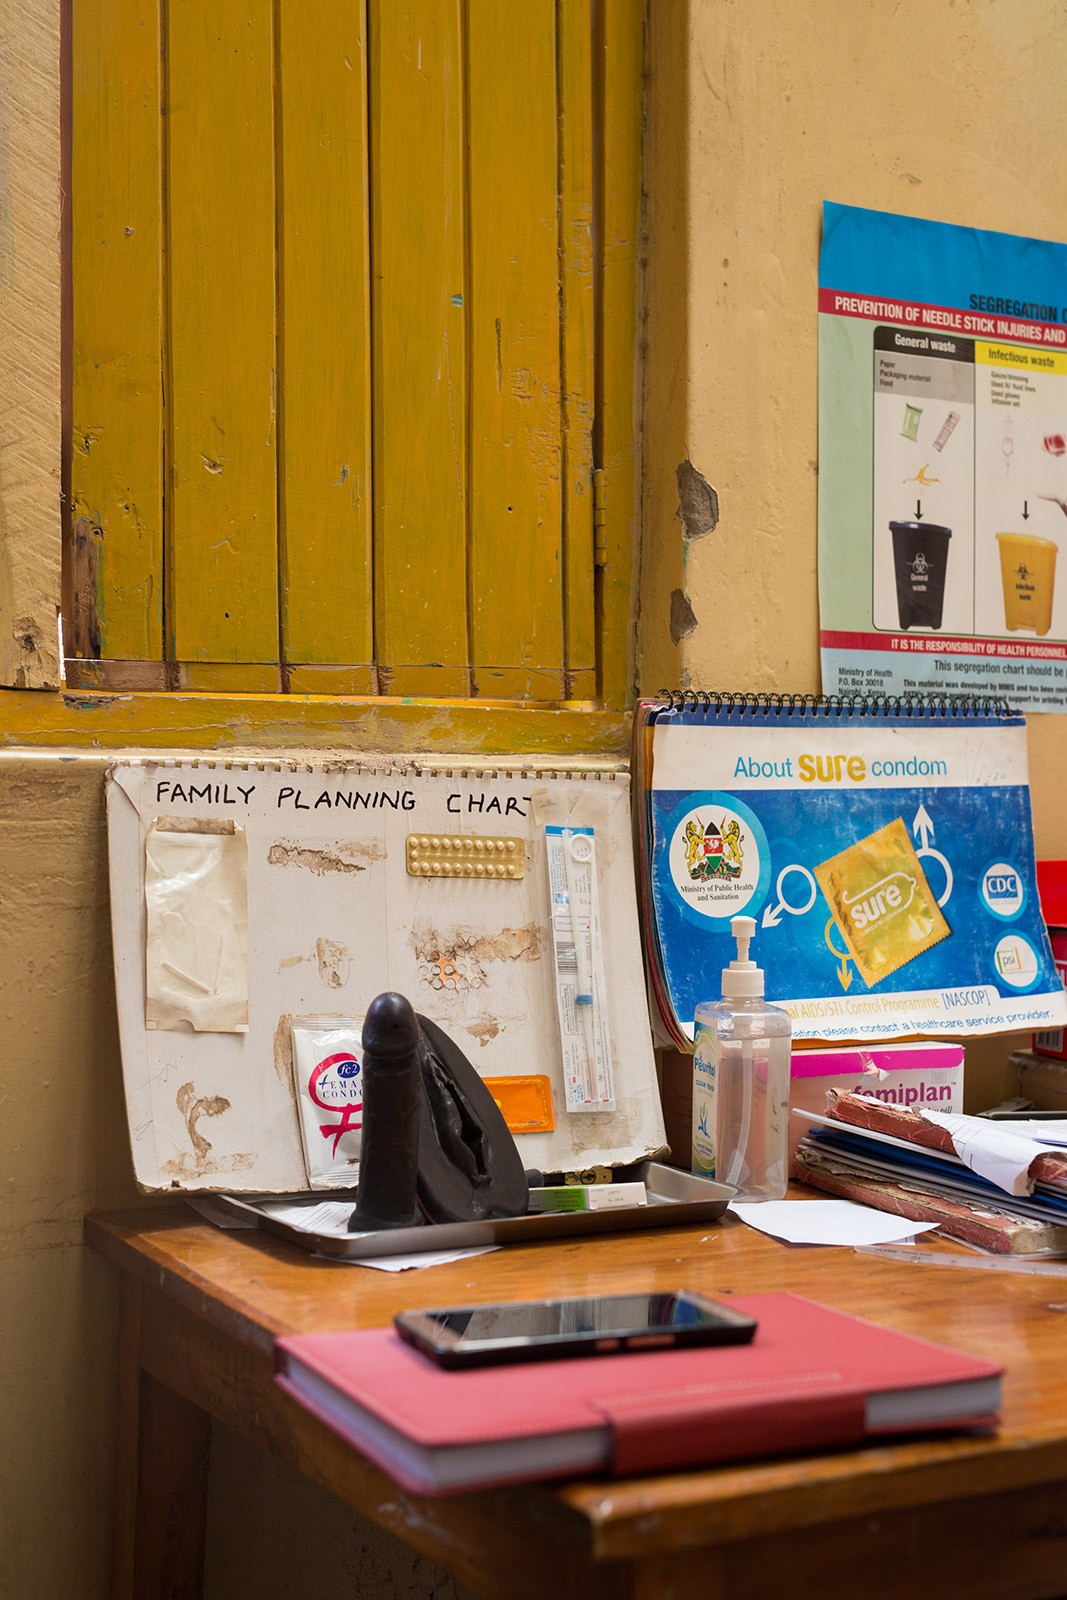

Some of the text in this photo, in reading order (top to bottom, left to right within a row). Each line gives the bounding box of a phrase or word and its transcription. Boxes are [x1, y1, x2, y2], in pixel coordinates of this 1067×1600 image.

[970, 293, 1058, 322] SEGREGATION
[835, 296, 1066, 343] PREVENTION OF NEEDLE STICK INJURIES AND
[895, 333, 957, 354] General waste
[880, 359, 896, 369] Paper
[988, 348, 1055, 368] Infectious waste
[880, 369, 931, 382] Packaging material
[880, 379, 893, 387] Food
[891, 639, 899, 650] IT
[900, 639, 908, 650] IS
[909, 640, 924, 651] THE
[925, 641, 986, 653] RESPONSIBILITY
[986, 643, 997, 654] OF
[997, 644, 1025, 656] HEALTH
[838, 667, 893, 678] Ministry of Health
[934, 659, 1064, 677] This segregation chart should be
[851, 678, 863, 686] Box
[865, 679, 884, 687] 30018
[903, 679, 916, 687] This
[918, 679, 944, 688] material
[945, 681, 959, 689] was
[960, 681, 988, 690] developed
[990, 682, 997, 691] by
[1016, 684, 1028, 692] and
[1029, 684, 1039, 692] has
[1040, 685, 1054, 693] been
[733, 753, 948, 783] About sure condom
[156, 781, 256, 805] FAMILY
[278, 786, 416, 812] PLANNING
[681, 885, 705, 894] Ministry
[715, 884, 733, 892] Public
[734, 883, 754, 891] Health
[987, 876, 1017, 894] CDC
[709, 893, 739, 901] Sanitation
[850, 885, 903, 928] sure
[1001, 954, 1016, 967] psi
[801, 1001, 844, 1019] AIDS/STI
[845, 998, 882, 1015] Control
[883, 993, 940, 1015] Programme
[941, 989, 991, 1010] [NASCOP]
[823, 1025, 859, 1037] please
[860, 1021, 900, 1033] contact
[902, 1022, 910, 1030] a
[910, 1018, 964, 1030] healthcare
[965, 1015, 1005, 1027] service
[1006, 1009, 1054, 1023] provider.
[338, 1064, 358, 1075] fc2
